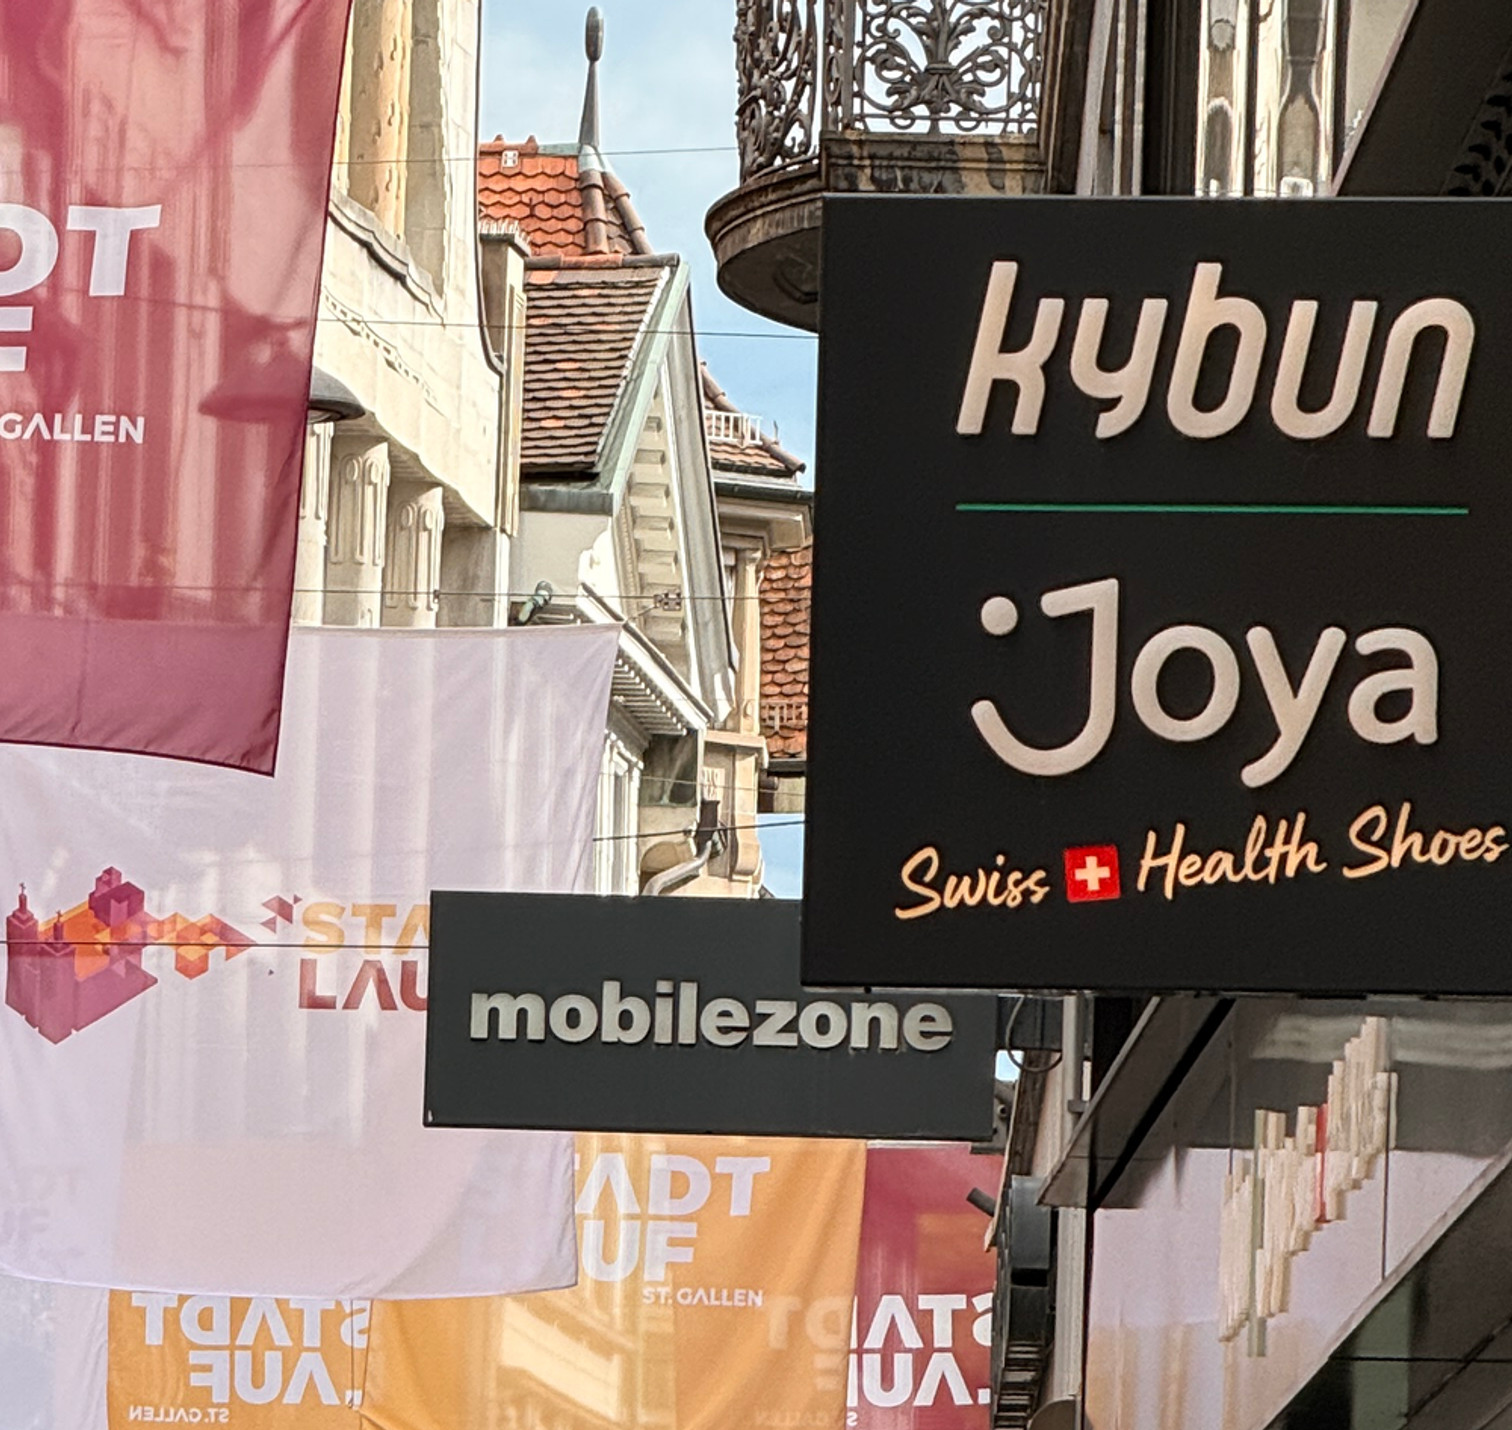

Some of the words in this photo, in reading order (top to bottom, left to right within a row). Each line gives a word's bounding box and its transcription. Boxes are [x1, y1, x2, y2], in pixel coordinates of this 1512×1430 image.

[955, 260, 1476, 440] kybun
[971, 578, 1440, 789] Joya
[894, 847, 1050, 920] Swiss
[1136, 812, 1328, 901] Health
[1341, 802, 1510, 881] Shoes
[470, 980, 953, 1051] mobilezone
[575, 1153, 771, 1216] ADT
[642, 1287, 673, 1306] ST.
[677, 1289, 764, 1307] GALLEN
